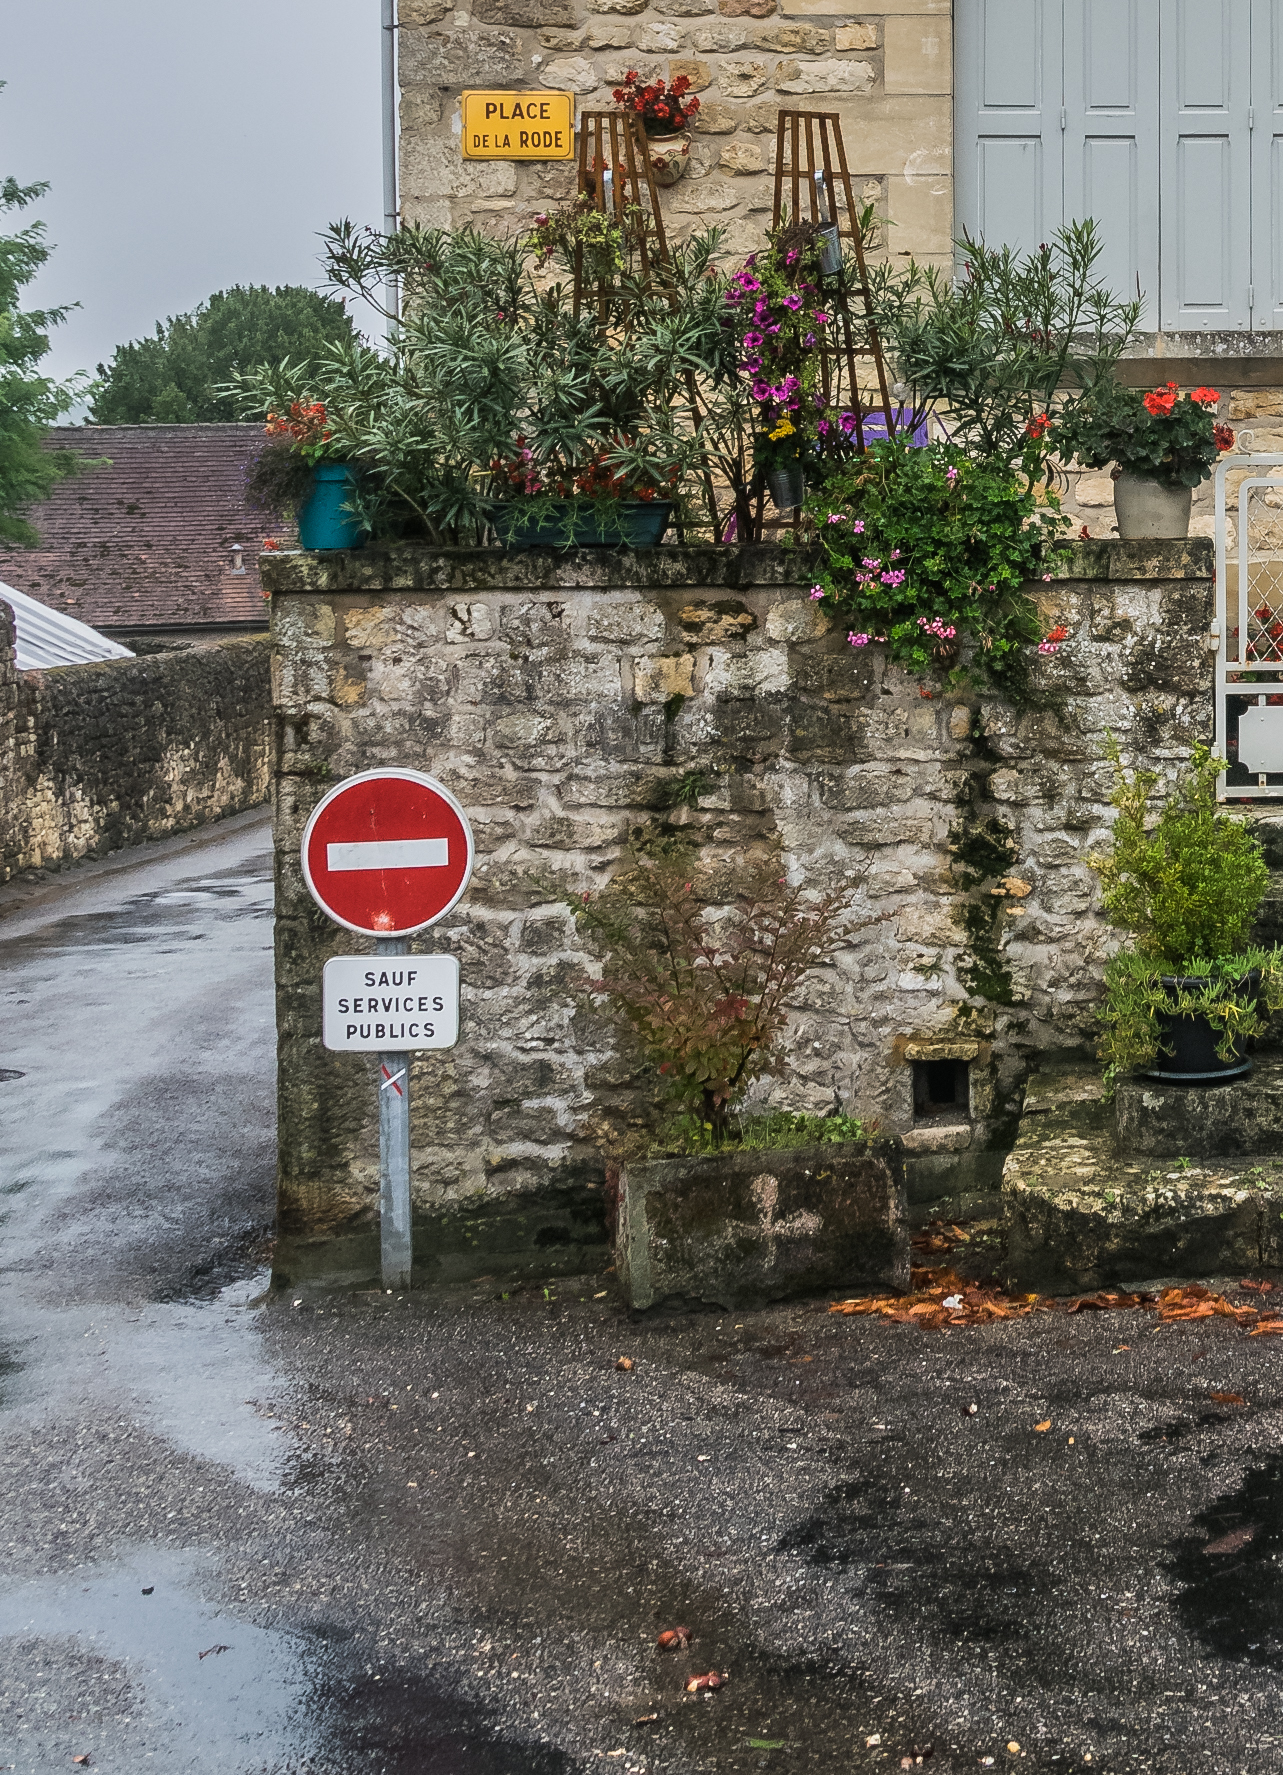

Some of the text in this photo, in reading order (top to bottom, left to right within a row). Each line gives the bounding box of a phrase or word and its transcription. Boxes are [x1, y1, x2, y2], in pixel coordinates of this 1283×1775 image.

[485, 102, 551, 120] PLACE
[473, 130, 563, 149] DE LA RODE
[364, 970, 418, 987] SAUF
[337, 996, 444, 1014] SERVICES
[346, 1022, 435, 1040] PUBLICS
